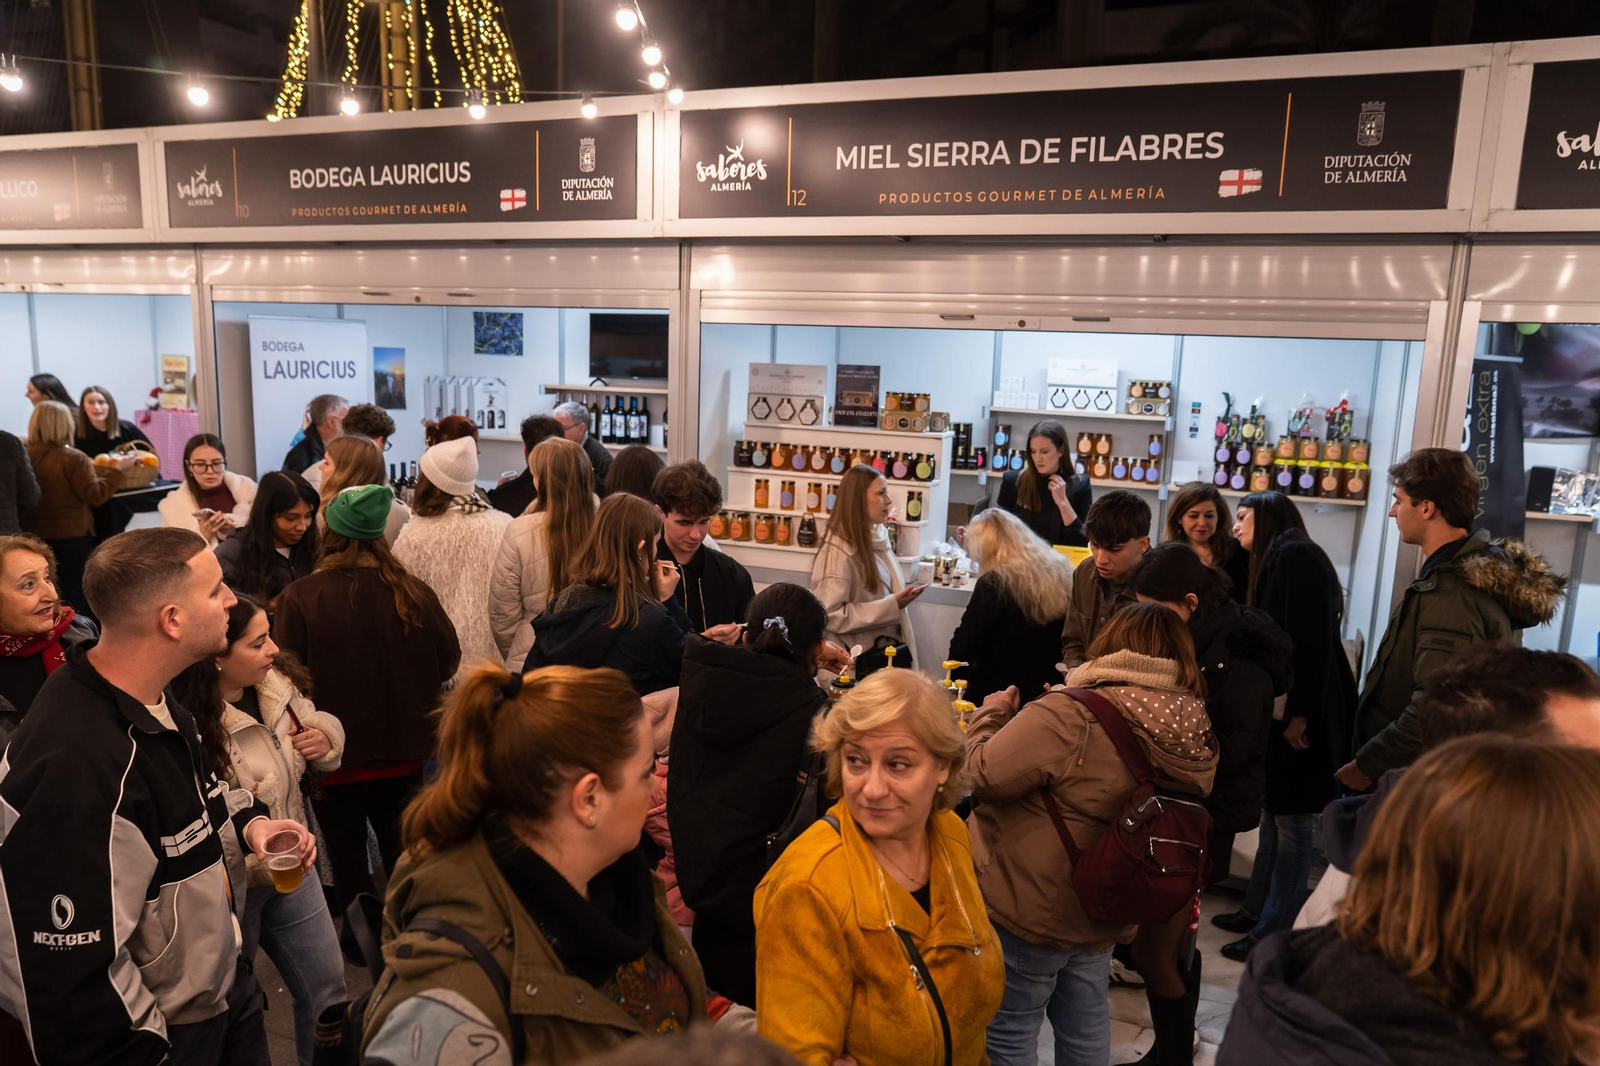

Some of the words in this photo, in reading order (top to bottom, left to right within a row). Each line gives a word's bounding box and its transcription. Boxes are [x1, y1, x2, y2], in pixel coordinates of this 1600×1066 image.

[1556, 121, 1600, 157] sa
[836, 144, 900, 170] MIEL
[907, 140, 1011, 168] SIERRA
[1020, 137, 1061, 164] DE
[1070, 131, 1225, 163] FILABRES
[1324, 151, 1412, 168] DIPUTACIÓN
[696, 153, 767, 182] sabores
[1578, 159, 1600, 170] AL
[289, 166, 366, 189] BODEGA
[370, 161, 471, 186] LAURICIUS
[561, 175, 614, 189] DIPUTACIÓN
[1324, 171, 1342, 184] DE
[1345, 168, 1408, 183] ALMERÍA
[177, 175, 223, 199] sabores
[562, 190, 574, 201] DE
[575, 188, 613, 201] ALMERÍA
[710, 181, 752, 192] ALMERÍA
[879, 191, 973, 204] PRODUCTOS
[977, 189, 1056, 202] GOURMET
[1062, 188, 1083, 201] DE
[1088, 185, 1165, 200] ALMERÍA
[791, 189, 807, 206] 12
[291, 206, 350, 217] PRODUCTOS
[352, 204, 401, 216] GOURMET
[403, 204, 417, 215] DE
[419, 202, 468, 214] ALMERÍA
[262, 340, 305, 352] BODEGA
[263, 359, 356, 379] LAURICIUS
[1476, 370, 1491, 433] extra
[1489, 369, 1499, 464] www.lasolana2.es
